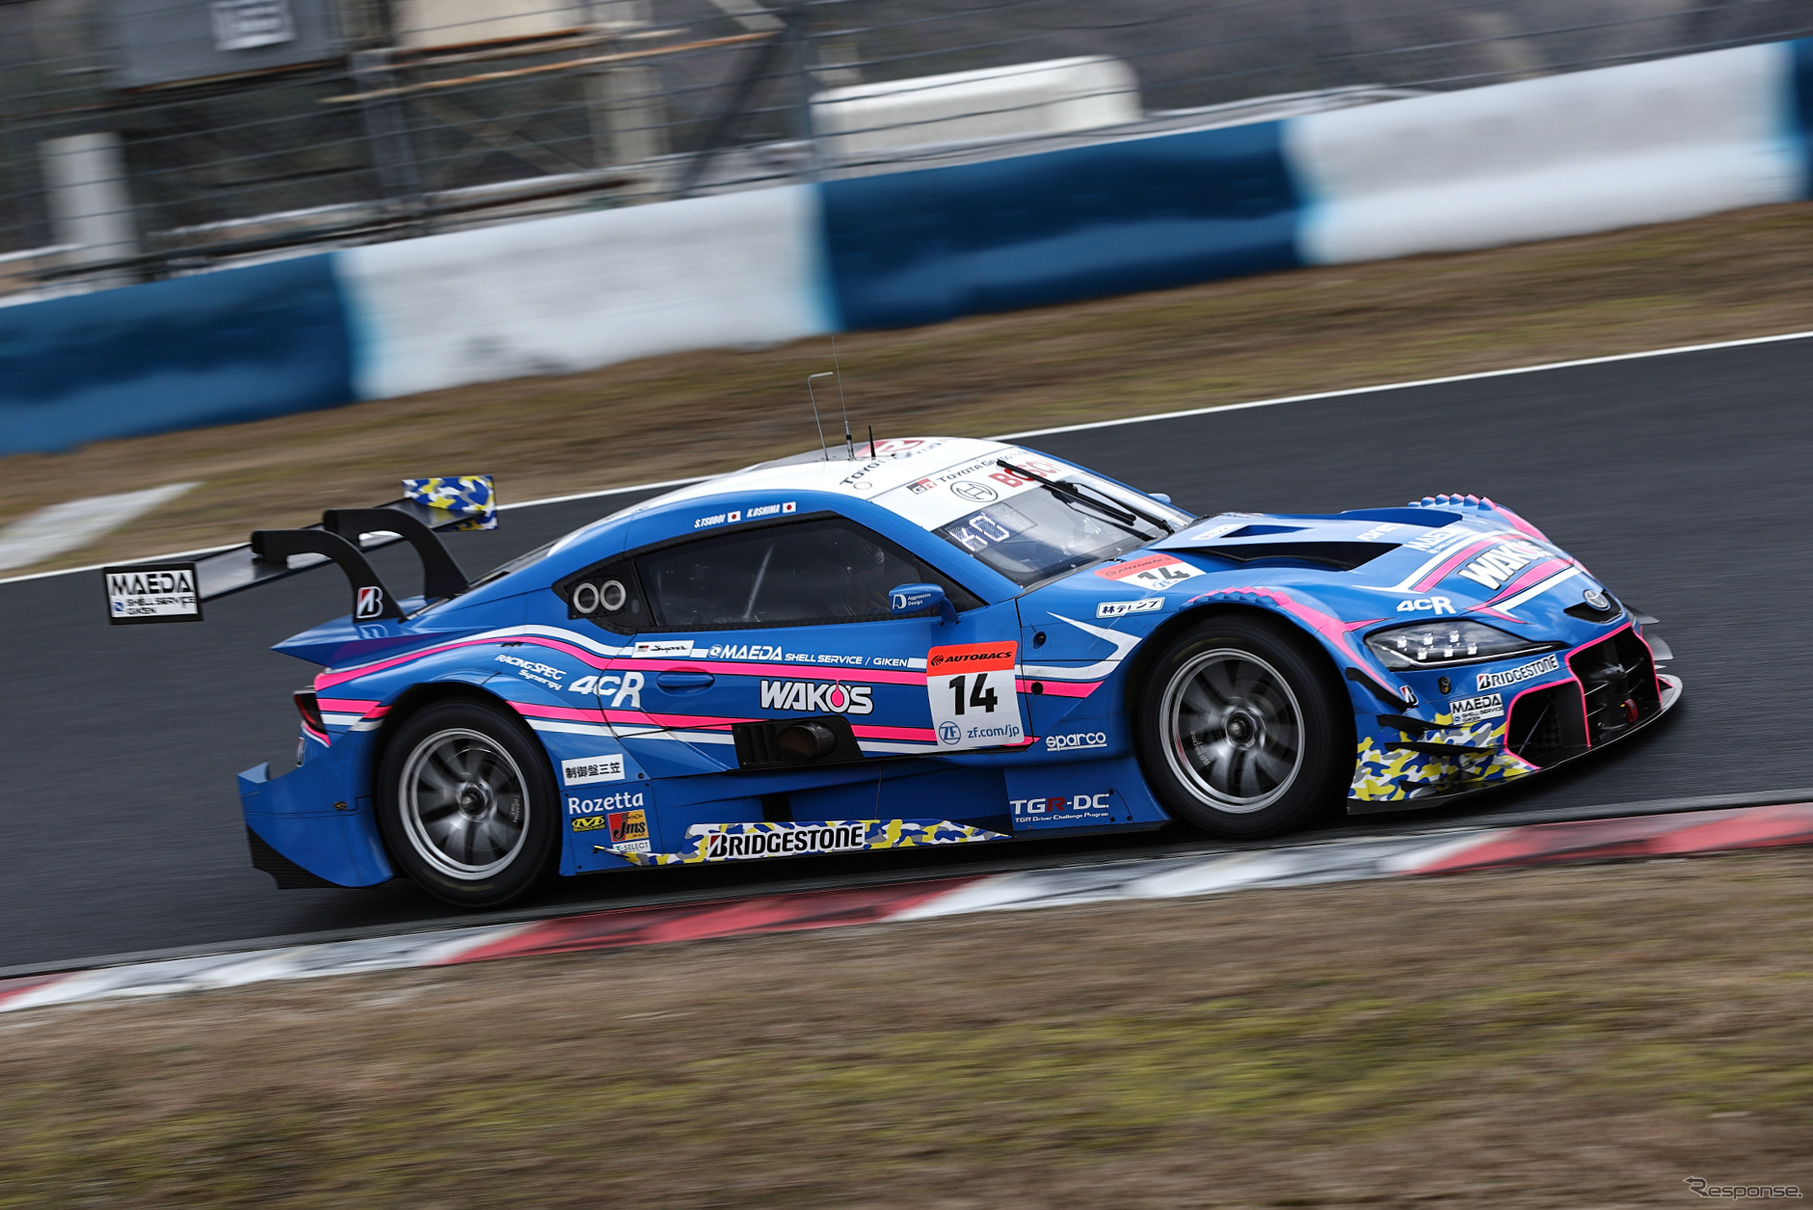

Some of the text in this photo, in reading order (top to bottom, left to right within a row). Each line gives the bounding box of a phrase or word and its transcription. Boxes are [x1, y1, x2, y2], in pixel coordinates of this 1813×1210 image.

[937, 465, 982, 482] TOYOTA
[746, 504, 780, 518] K.OSHIMA
[1137, 567, 1190, 580] 14
[111, 573, 195, 596] MAEDA
[1396, 596, 1457, 615] 4CR
[720, 645, 782, 661] MAEDA
[784, 653, 816, 663] SHELL
[817, 654, 863, 664] SERVICE
[873, 657, 908, 667] GIKEN
[944, 651, 1013, 663] AUTOBACS
[518, 669, 563, 691] Synergy
[1478, 655, 1558, 690] BRIDGESTONE
[567, 671, 645, 708] 4CR
[760, 679, 874, 714] WAKO'S
[949, 673, 998, 715] 14
[1452, 695, 1503, 714] MAEDA
[940, 725, 960, 741] ZF
[966, 724, 1020, 739] zf.com/jp
[1045, 732, 1107, 751] sparco
[565, 762, 621, 778] 制御盤三笠
[568, 791, 645, 815] Rozetta
[1009, 793, 1110, 815] TGR-DC
[1084, 811, 1109, 819] Program
[708, 825, 864, 858] BRIDGESTONE
